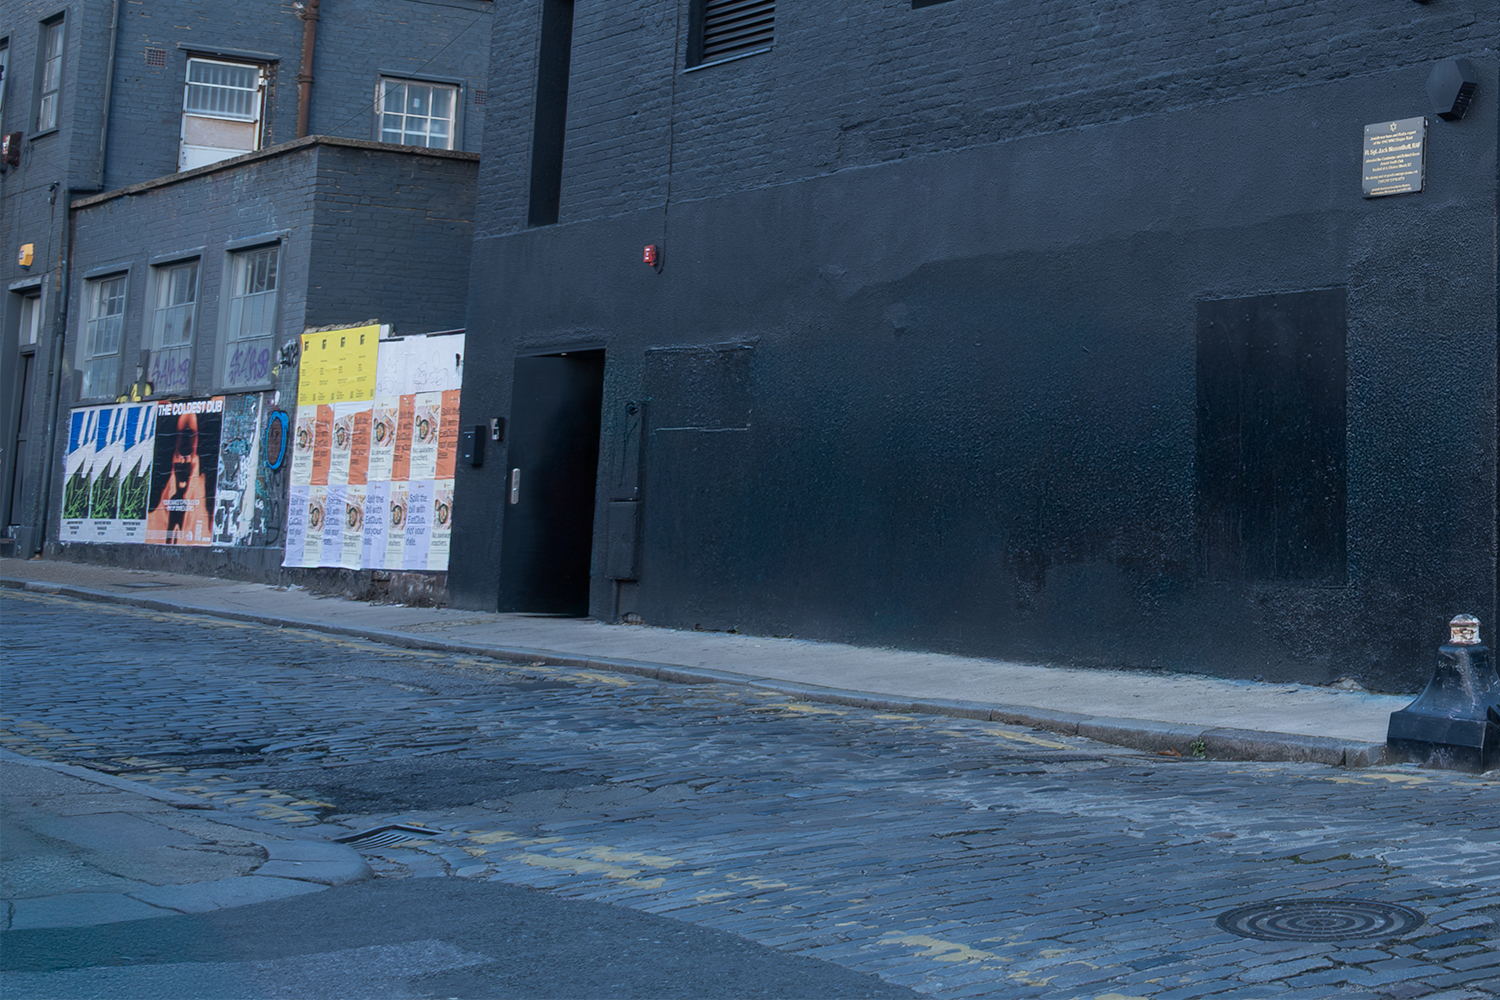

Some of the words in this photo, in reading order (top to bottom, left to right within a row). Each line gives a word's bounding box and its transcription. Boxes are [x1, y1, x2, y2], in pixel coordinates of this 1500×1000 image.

[158, 404, 172, 416] THE
[172, 401, 206, 416] COLDEST
[206, 400, 222, 413] DUB
